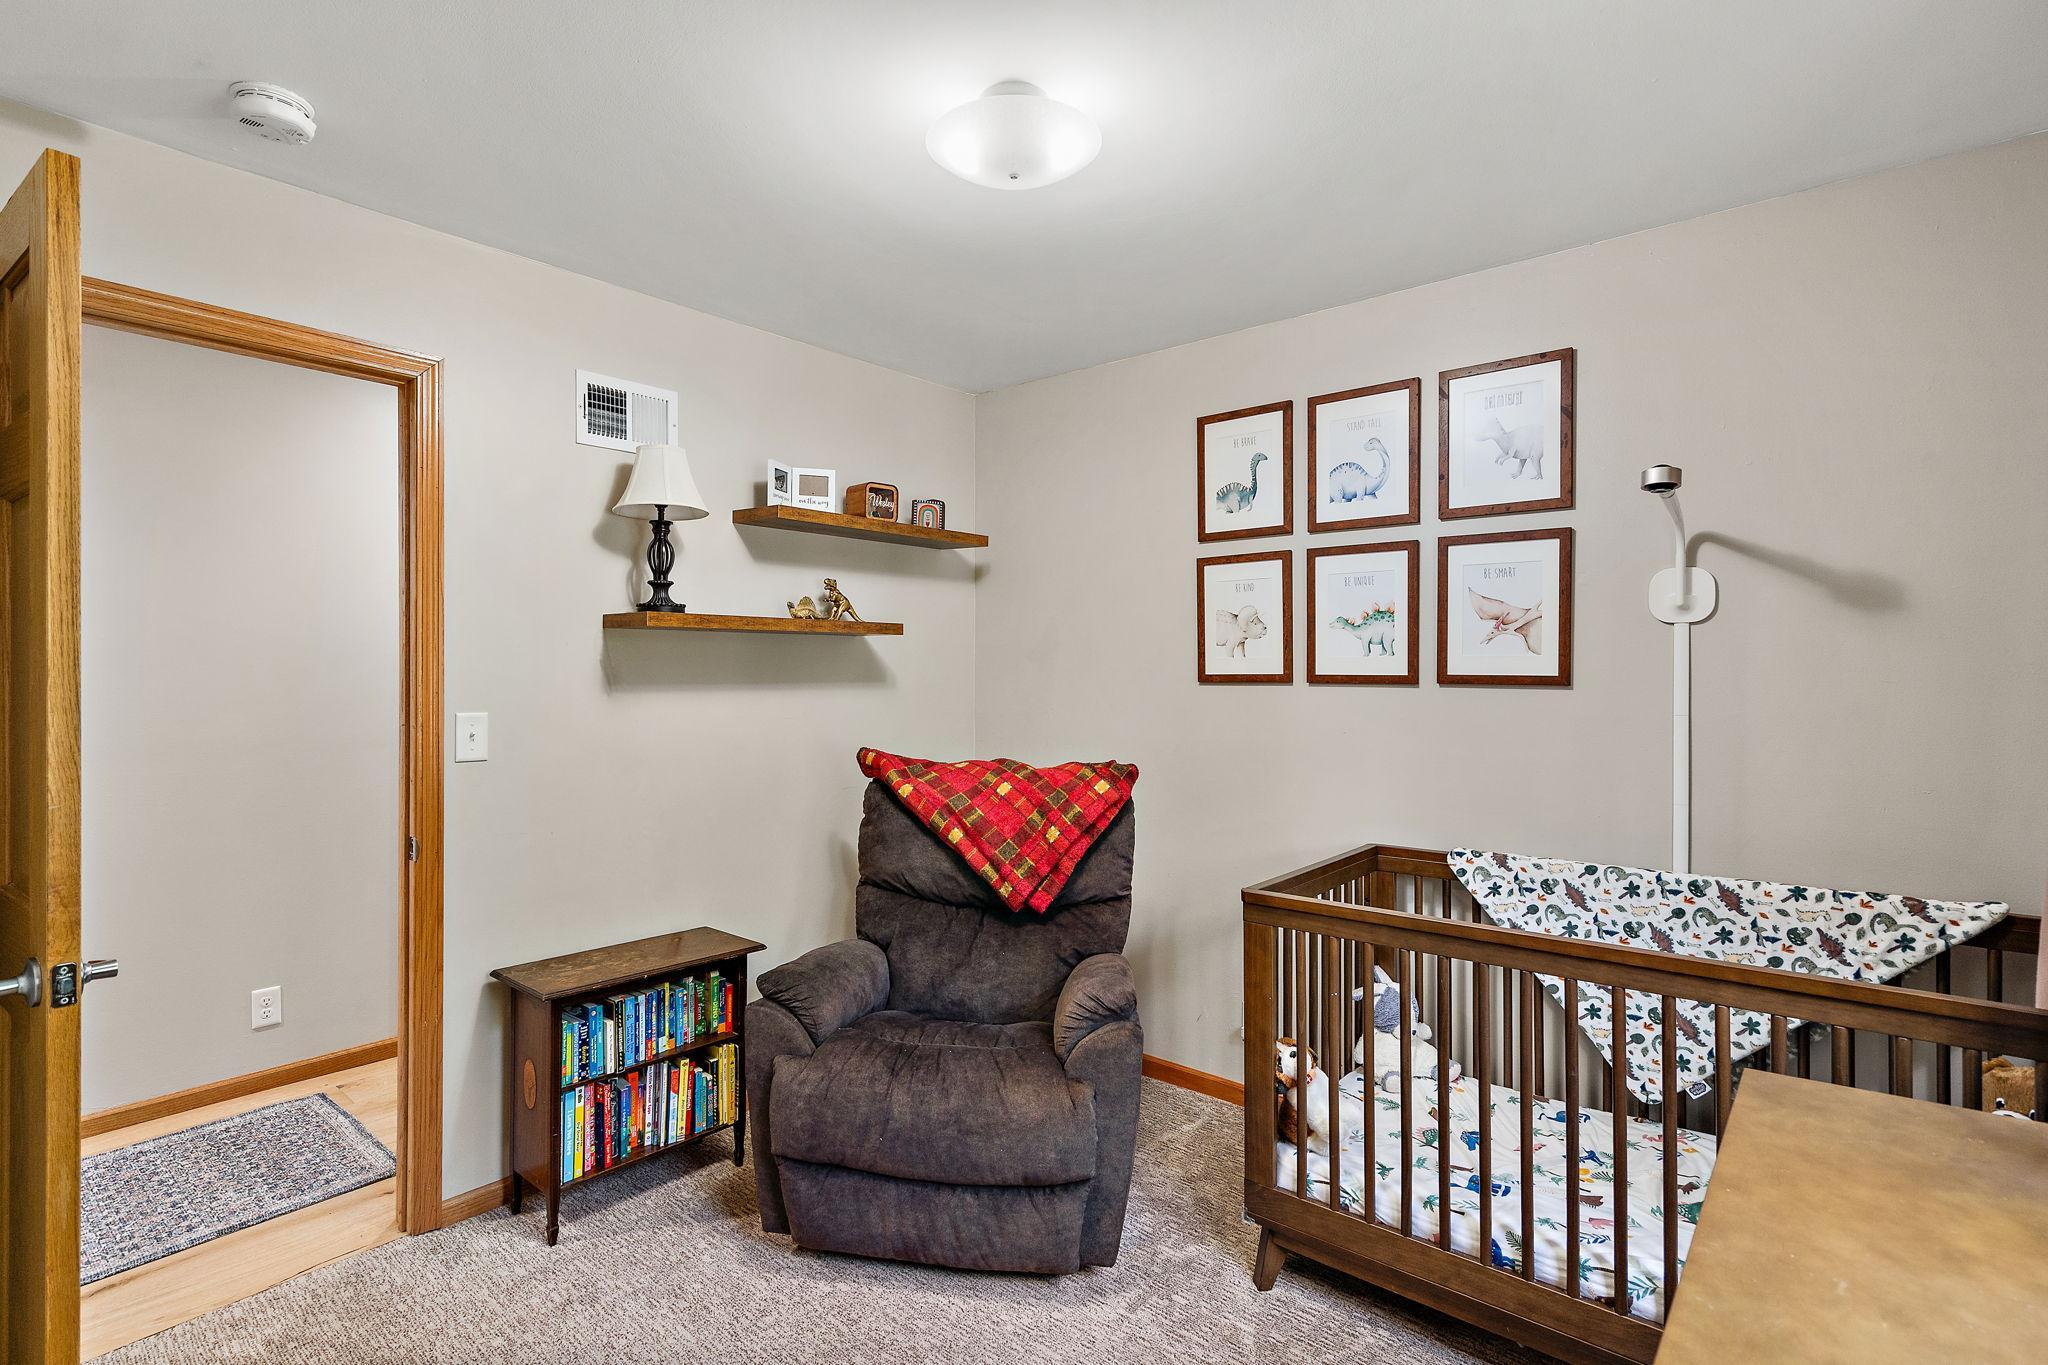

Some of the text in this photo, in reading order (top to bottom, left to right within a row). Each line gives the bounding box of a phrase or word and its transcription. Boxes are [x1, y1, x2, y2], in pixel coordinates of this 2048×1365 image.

[1483, 566, 1516, 579] BE SMART
[1344, 576, 1351, 587] BE
